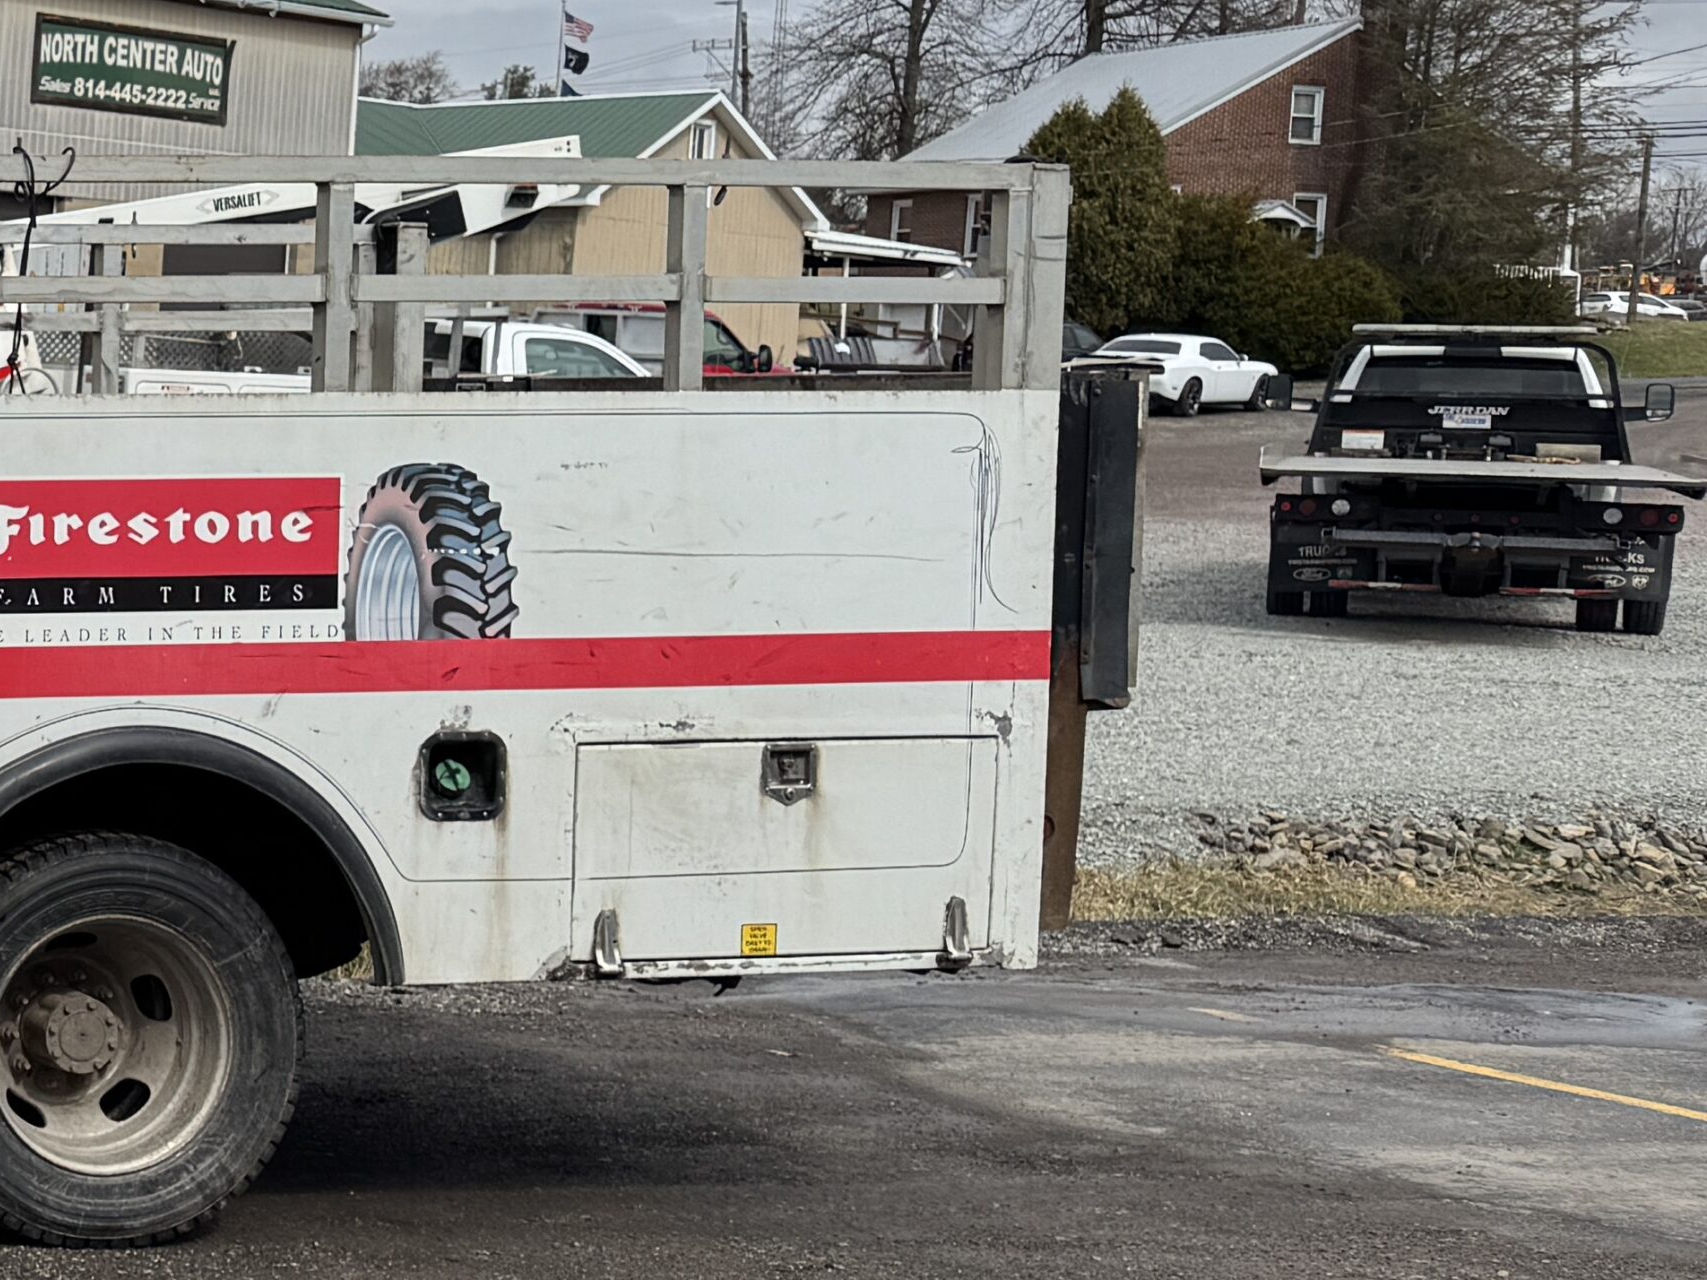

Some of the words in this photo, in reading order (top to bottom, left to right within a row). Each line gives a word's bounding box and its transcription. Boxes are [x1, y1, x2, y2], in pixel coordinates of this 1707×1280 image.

[40, 32, 99, 64] NORTH
[103, 35, 177, 75] CENTER
[181, 48, 223, 86] AUTO
[73, 77, 187, 109] 814-445-2222
[212, 191, 261, 212] VERSALIFT
[159, 583, 304, 605] TIRES
[25, 628, 128, 643] LEADER
[148, 627, 174, 641] IN
[193, 625, 242, 640] THE
[261, 624, 339, 639] FIELD
